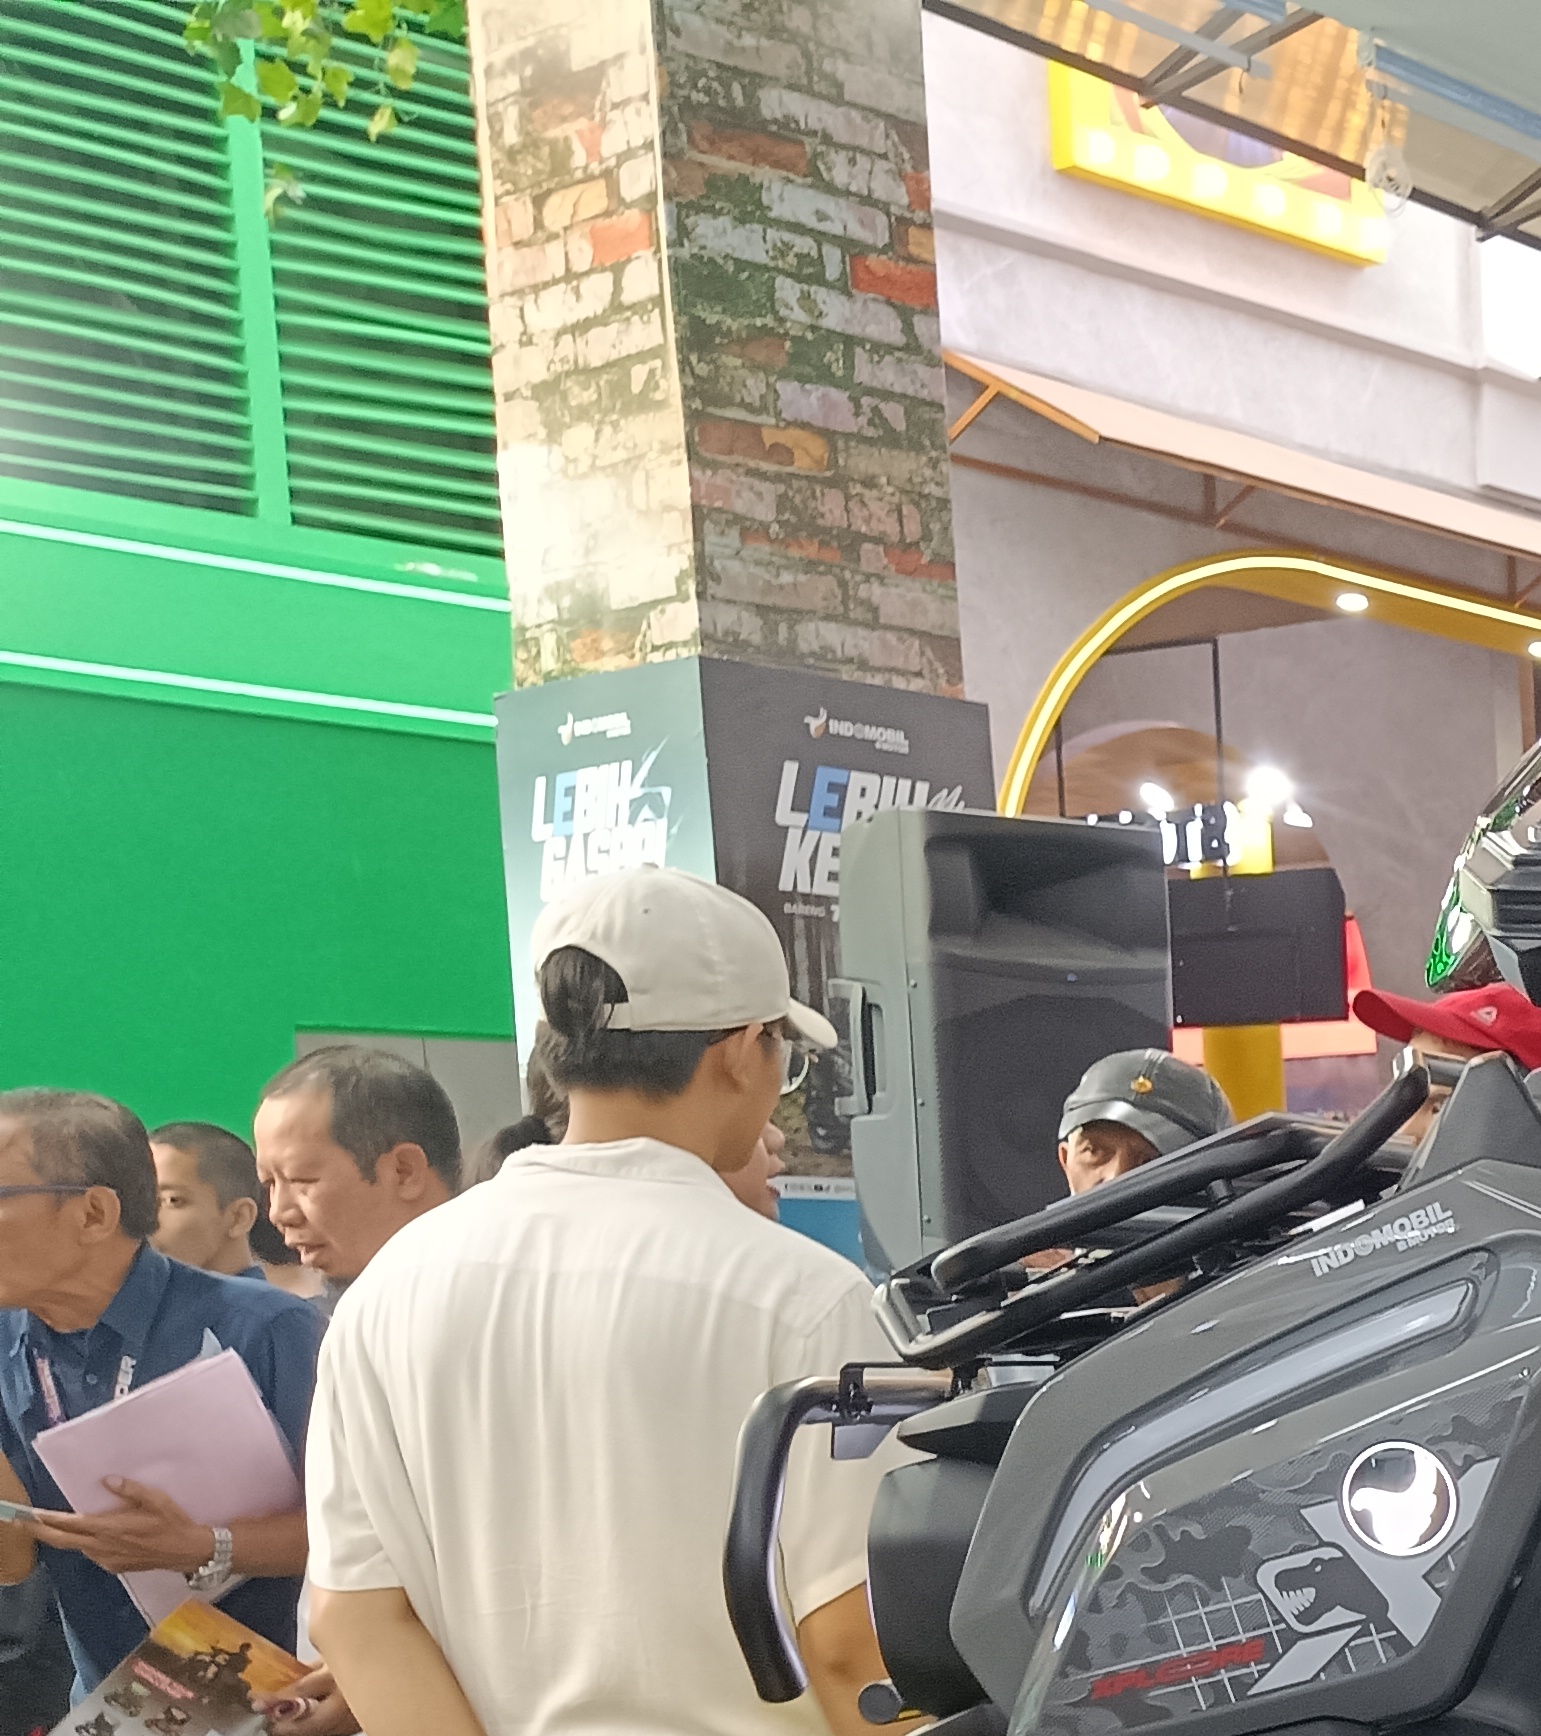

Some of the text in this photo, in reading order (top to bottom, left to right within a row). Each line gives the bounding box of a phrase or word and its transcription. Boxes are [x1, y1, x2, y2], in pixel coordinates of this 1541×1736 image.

[828, 719, 905, 743] INDOMOBIL
[531, 759, 633, 843] LEBIH
[1310, 1201, 1454, 1278] INDOMOBIL
